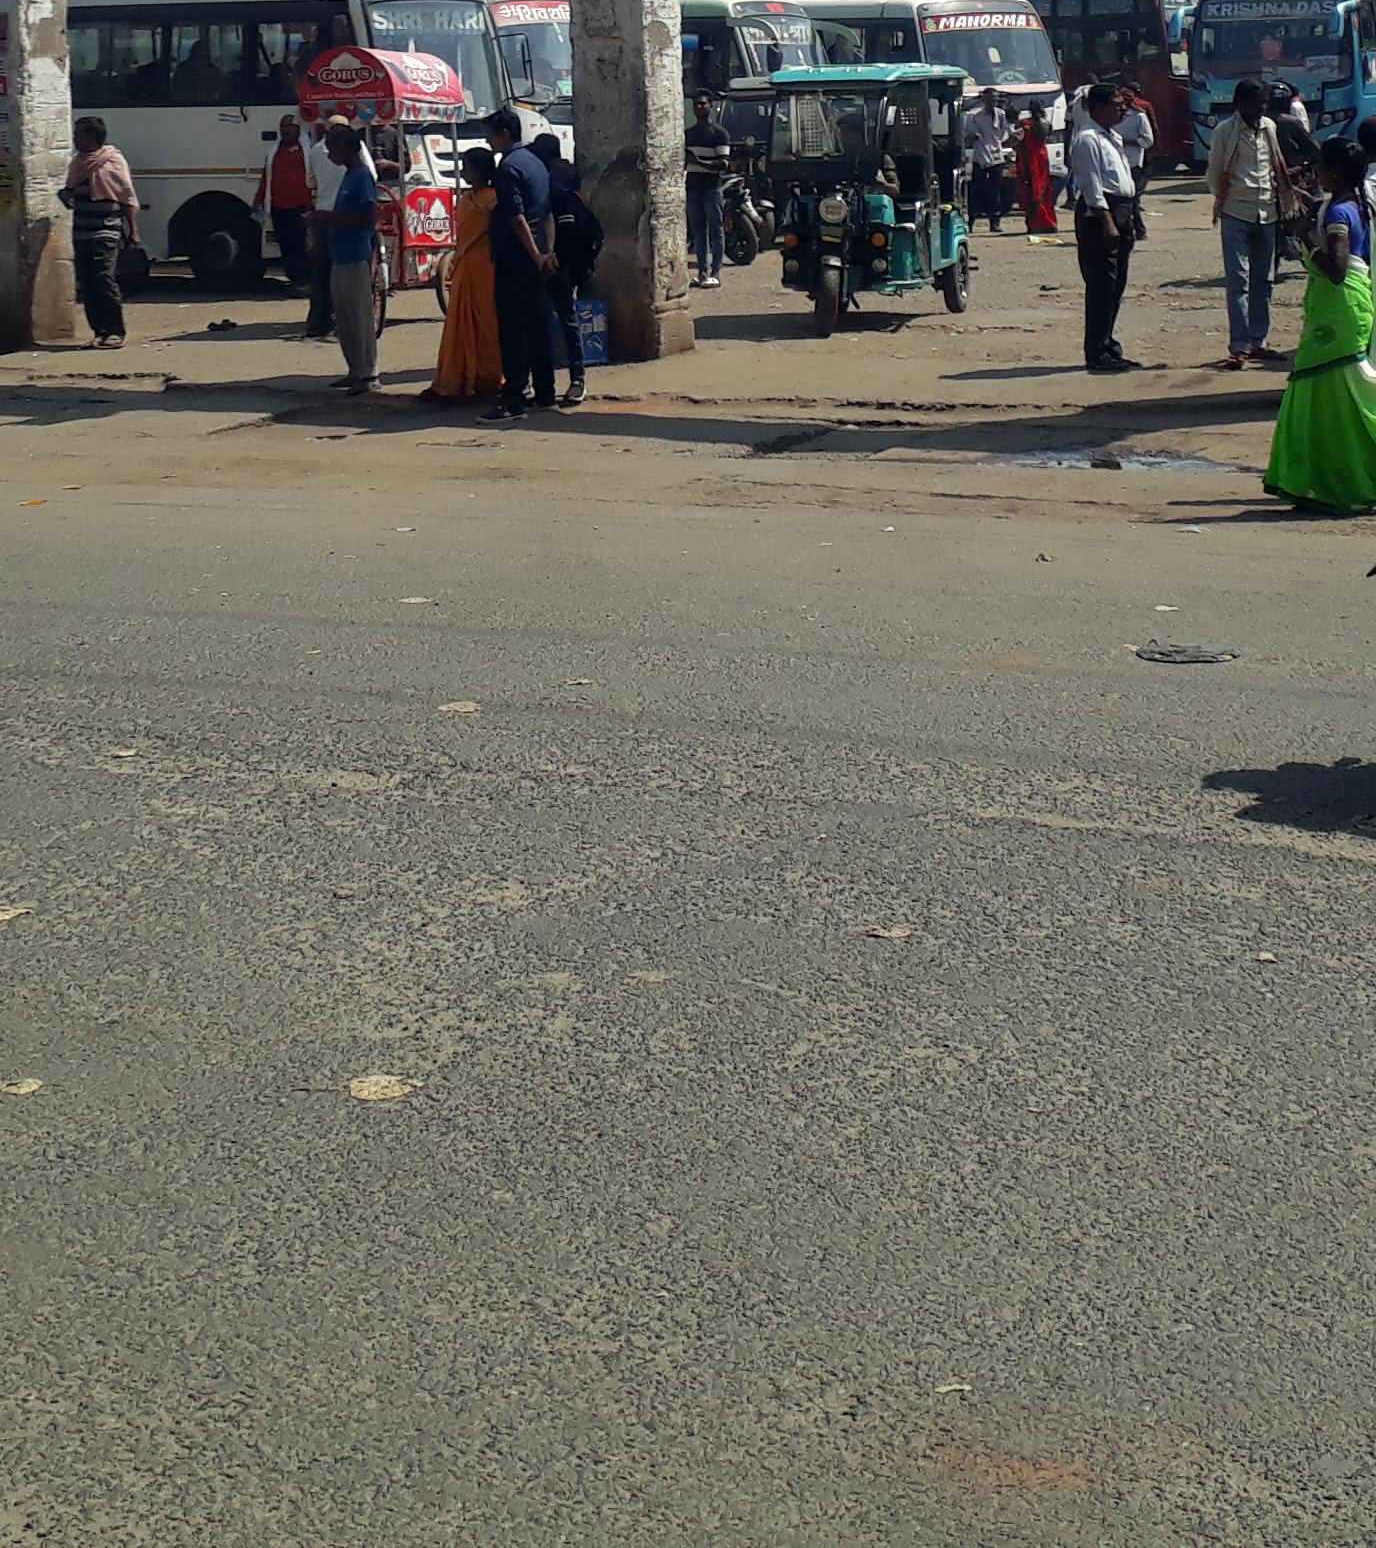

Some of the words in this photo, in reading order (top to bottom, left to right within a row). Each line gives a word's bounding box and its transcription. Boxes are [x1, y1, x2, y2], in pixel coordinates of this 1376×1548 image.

[1207, 1, 1292, 17] KRISHNA
[372, 10, 423, 30] SHRI
[433, 10, 487, 30] HARI
[938, 14, 1027, 30] MANORMA
[322, 68, 371, 82] GORUS
